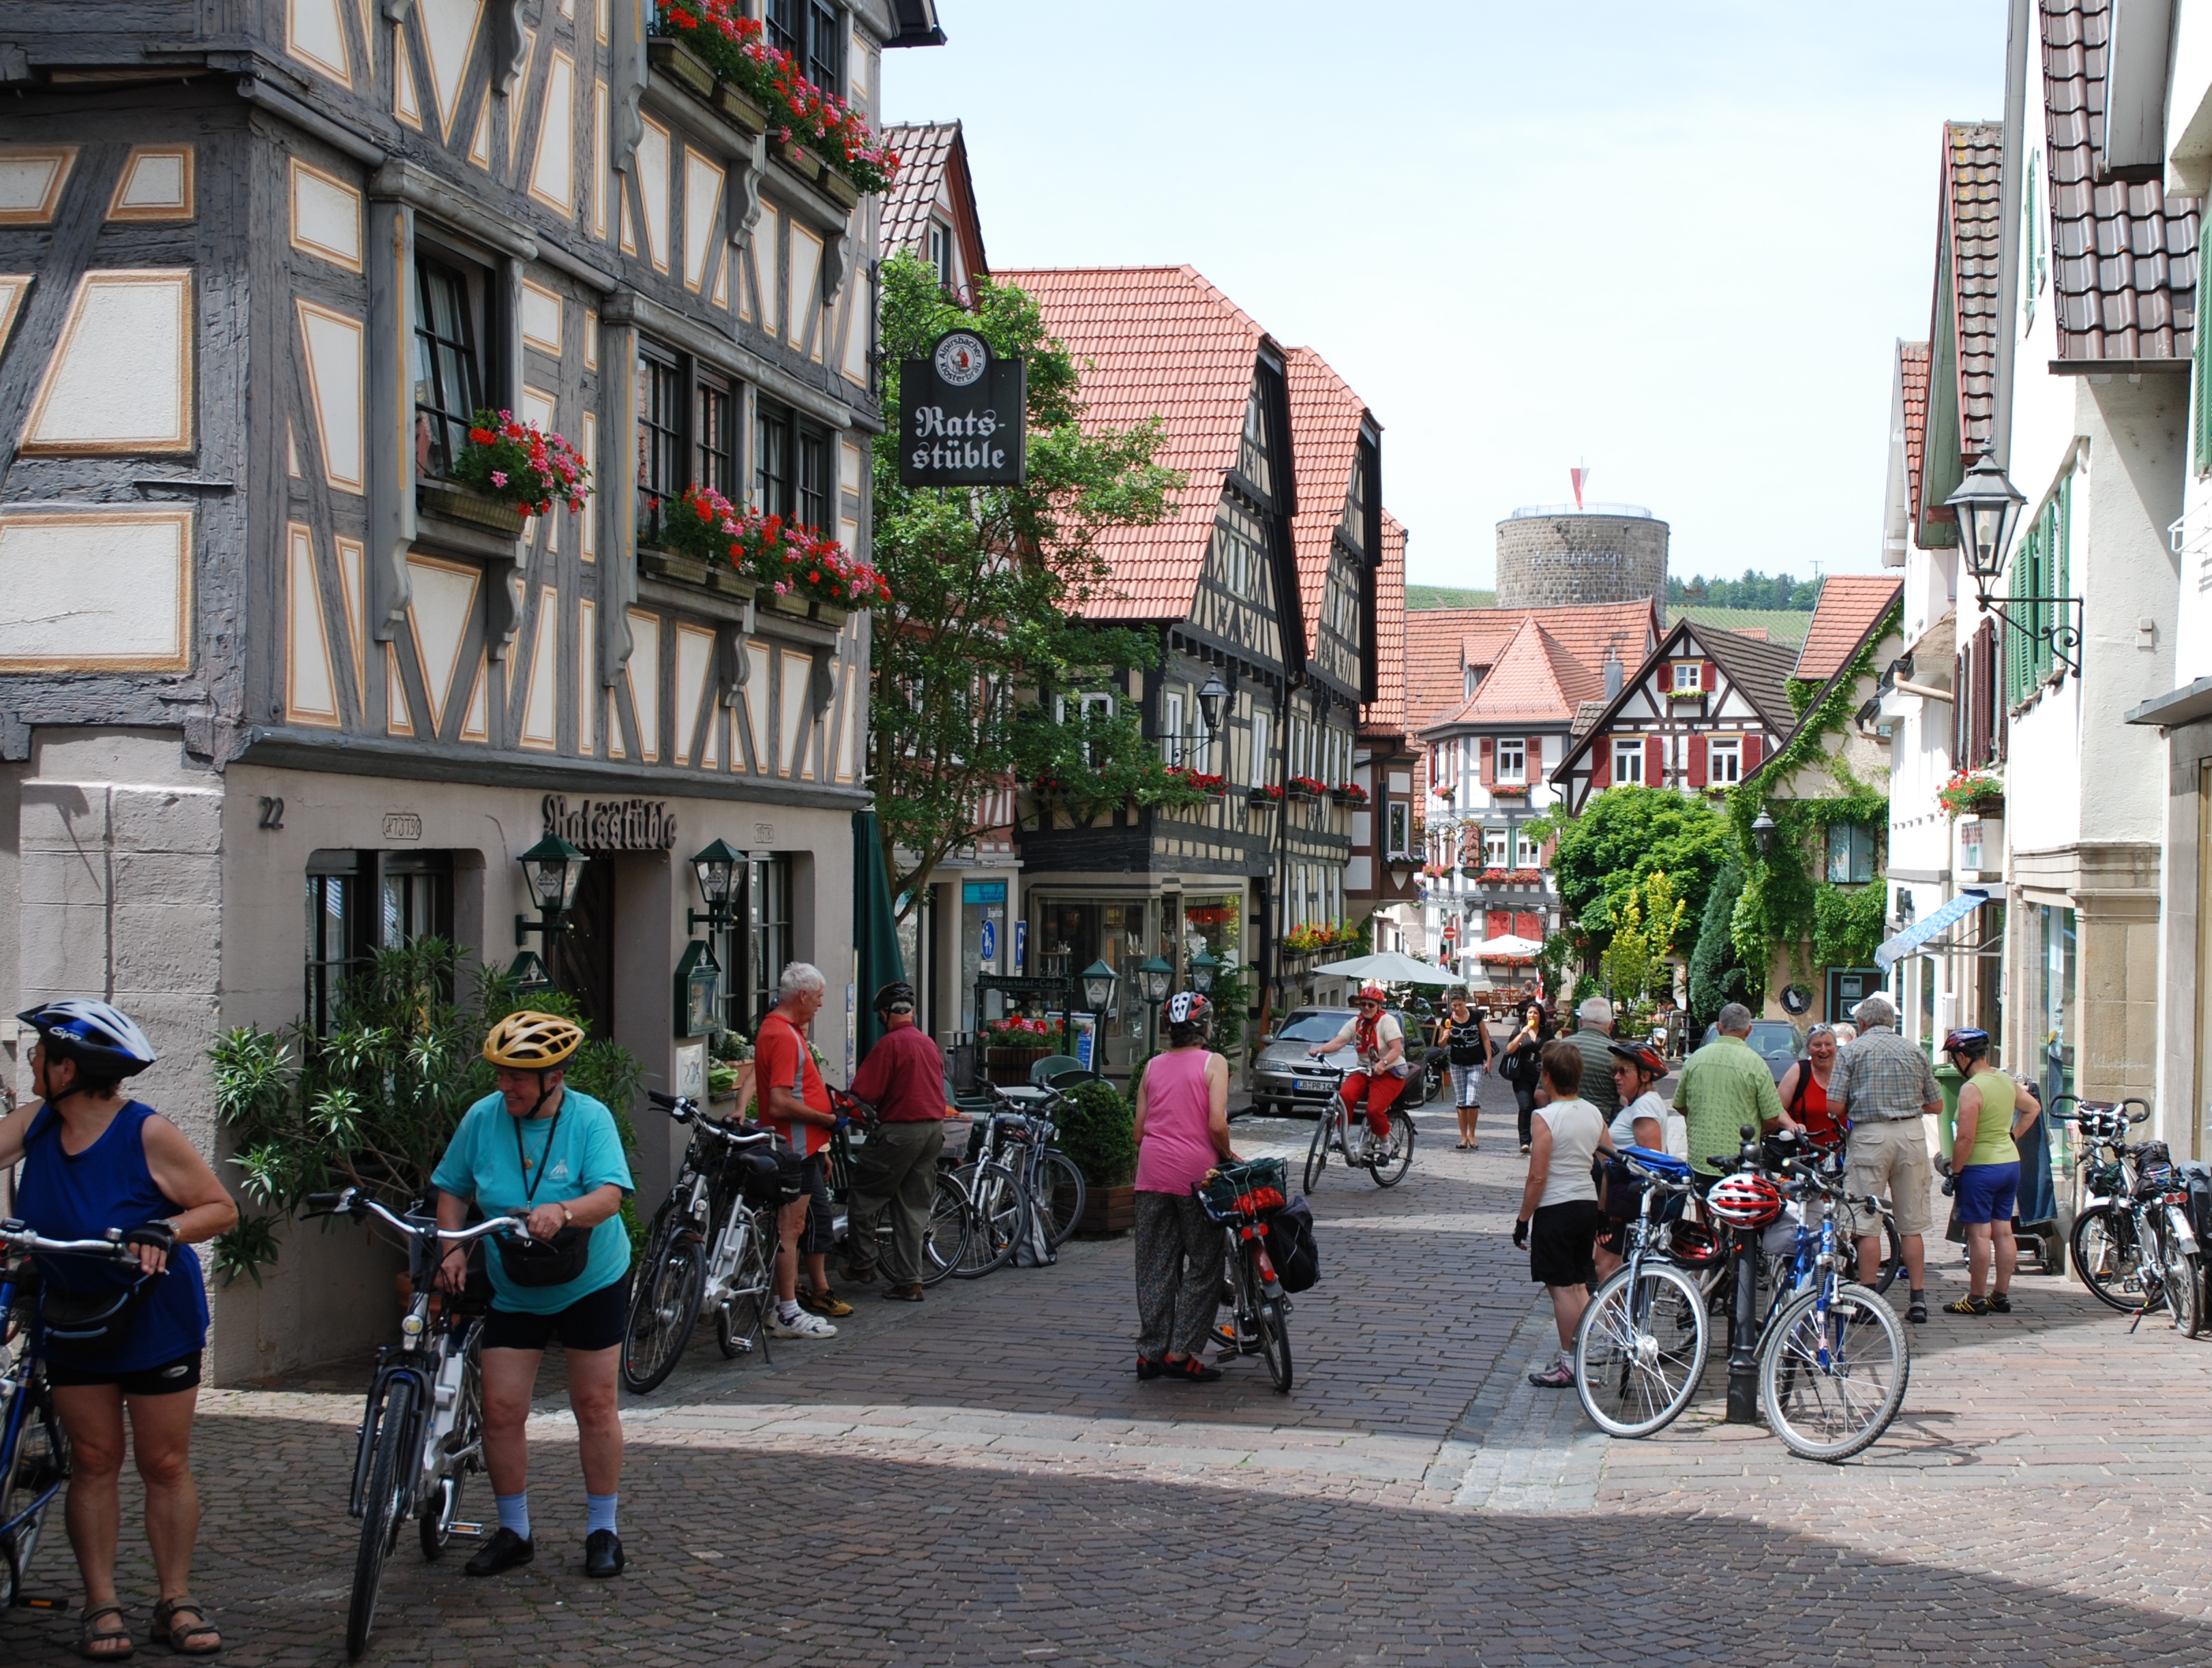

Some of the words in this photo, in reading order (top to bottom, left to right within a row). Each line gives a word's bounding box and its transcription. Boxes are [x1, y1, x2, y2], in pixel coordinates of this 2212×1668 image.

[939, 336, 983, 359] Alpirsbacher
[939, 361, 983, 383] Klosterbräu
[915, 406, 1006, 437] Rats-
[912, 440, 1006, 470] stüble
[259, 796, 285, 830] 22
[541, 794, 678, 850] Ratsstüble
[1017, 927, 1025, 961] P
[49, 1026, 82, 1041] Giro
[1298, 1081, 1308, 1089] LB
[1312, 1082, 1321, 1090] PR
